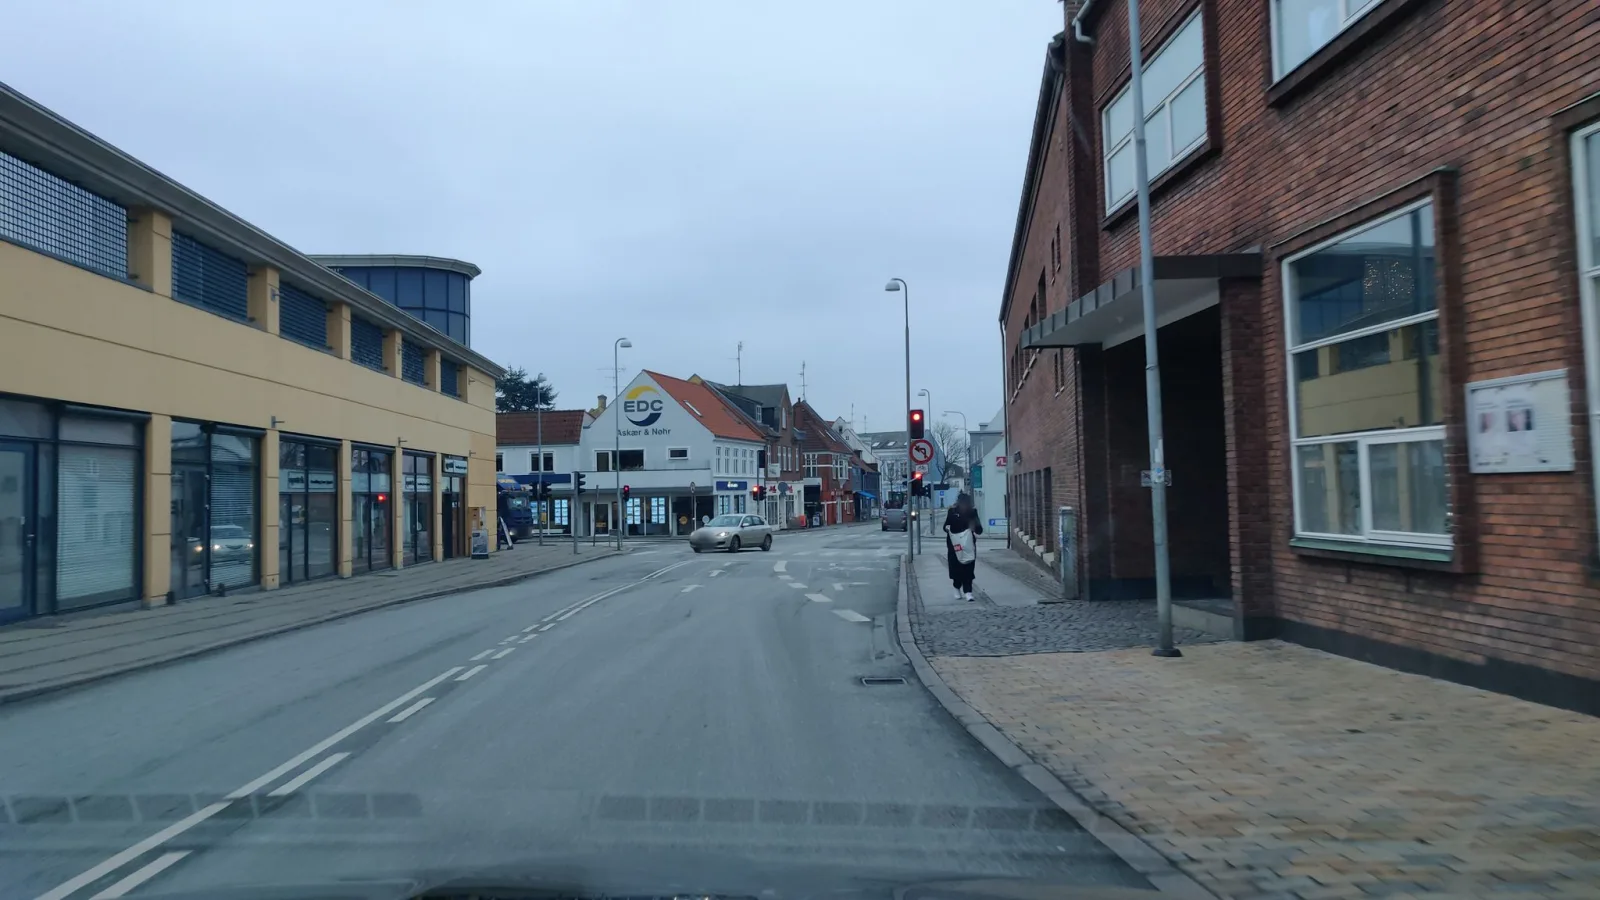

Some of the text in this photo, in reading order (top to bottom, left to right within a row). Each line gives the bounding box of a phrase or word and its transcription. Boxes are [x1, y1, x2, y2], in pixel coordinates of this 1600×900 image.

[624, 400, 663, 412] EDC
[617, 428, 641, 437] Askær
[652, 428, 671, 436] Nøhr
